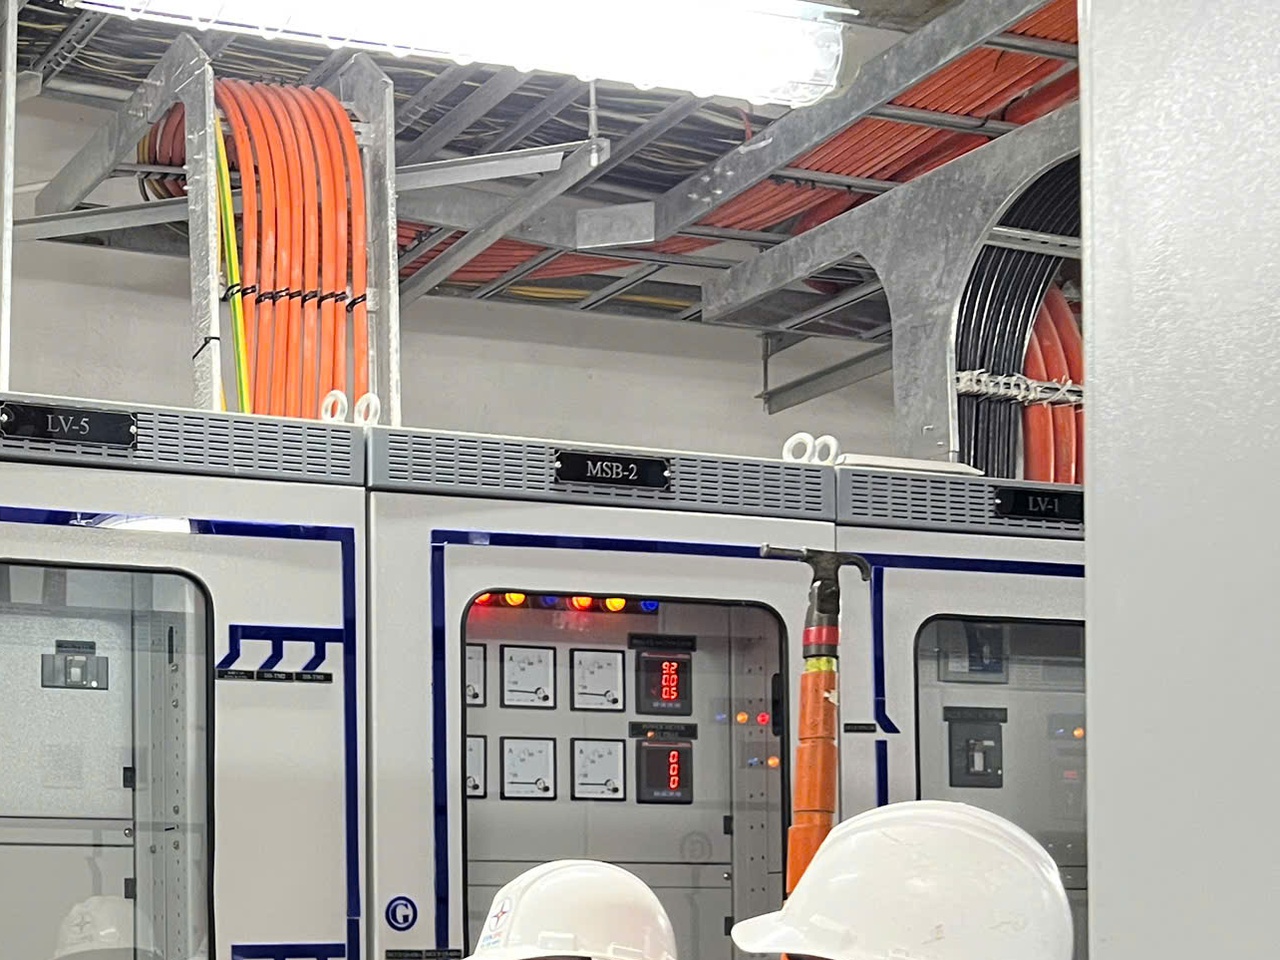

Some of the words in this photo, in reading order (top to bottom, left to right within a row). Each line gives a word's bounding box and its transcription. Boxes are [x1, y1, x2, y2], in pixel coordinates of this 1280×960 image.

[46, 414, 90, 435] LV-5
[586, 460, 638, 480] MSB-2
[1028, 496, 1059, 513] LV-1
